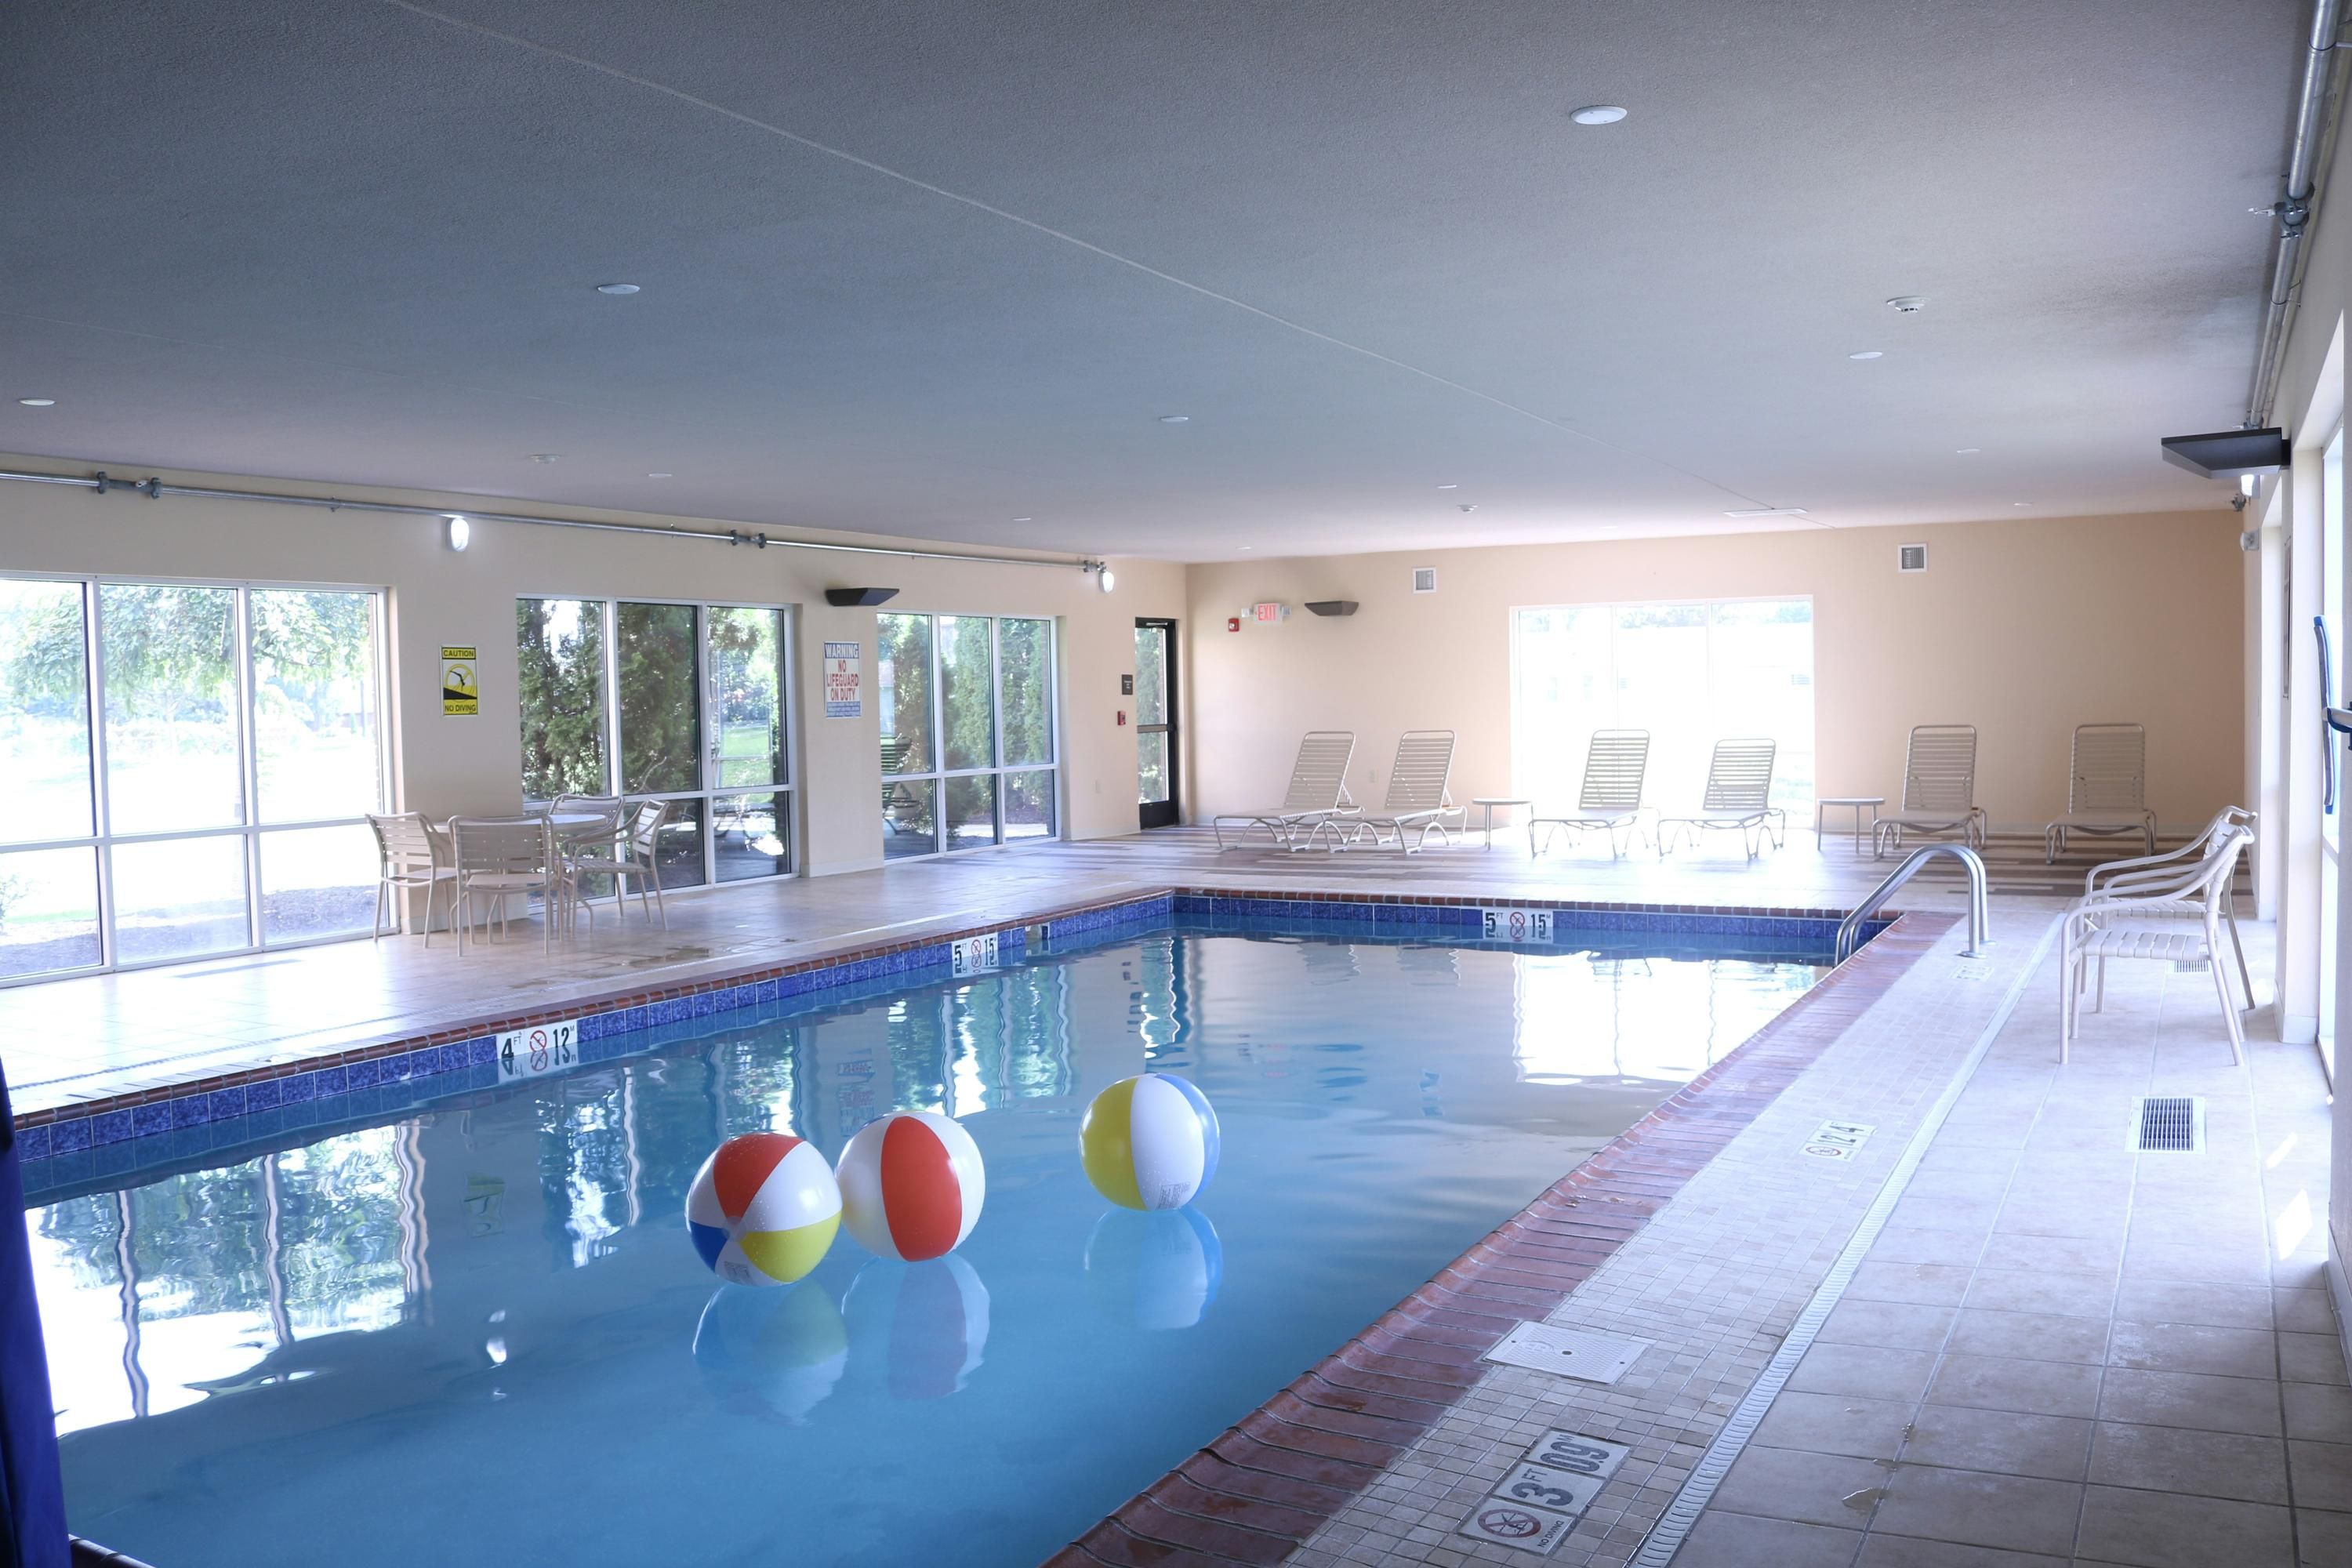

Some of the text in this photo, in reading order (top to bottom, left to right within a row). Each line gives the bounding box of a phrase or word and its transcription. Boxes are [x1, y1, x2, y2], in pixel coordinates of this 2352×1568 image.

[1258, 604, 1276, 621] EXIT
[825, 644, 858, 658] WARNING
[837, 659, 847, 672] NO
[826, 673, 859, 687] LIFEGUARD
[831, 688, 855, 700] ON DUTY
[1485, 912, 1496, 926] 5
[954, 944, 962, 960] 5
[501, 1038, 514, 1058] 4
[514, 1036, 521, 1045] FT
[1512, 1468, 1573, 1506] 3 FT
[1537, 1520, 1565, 1548] NO DIVING
